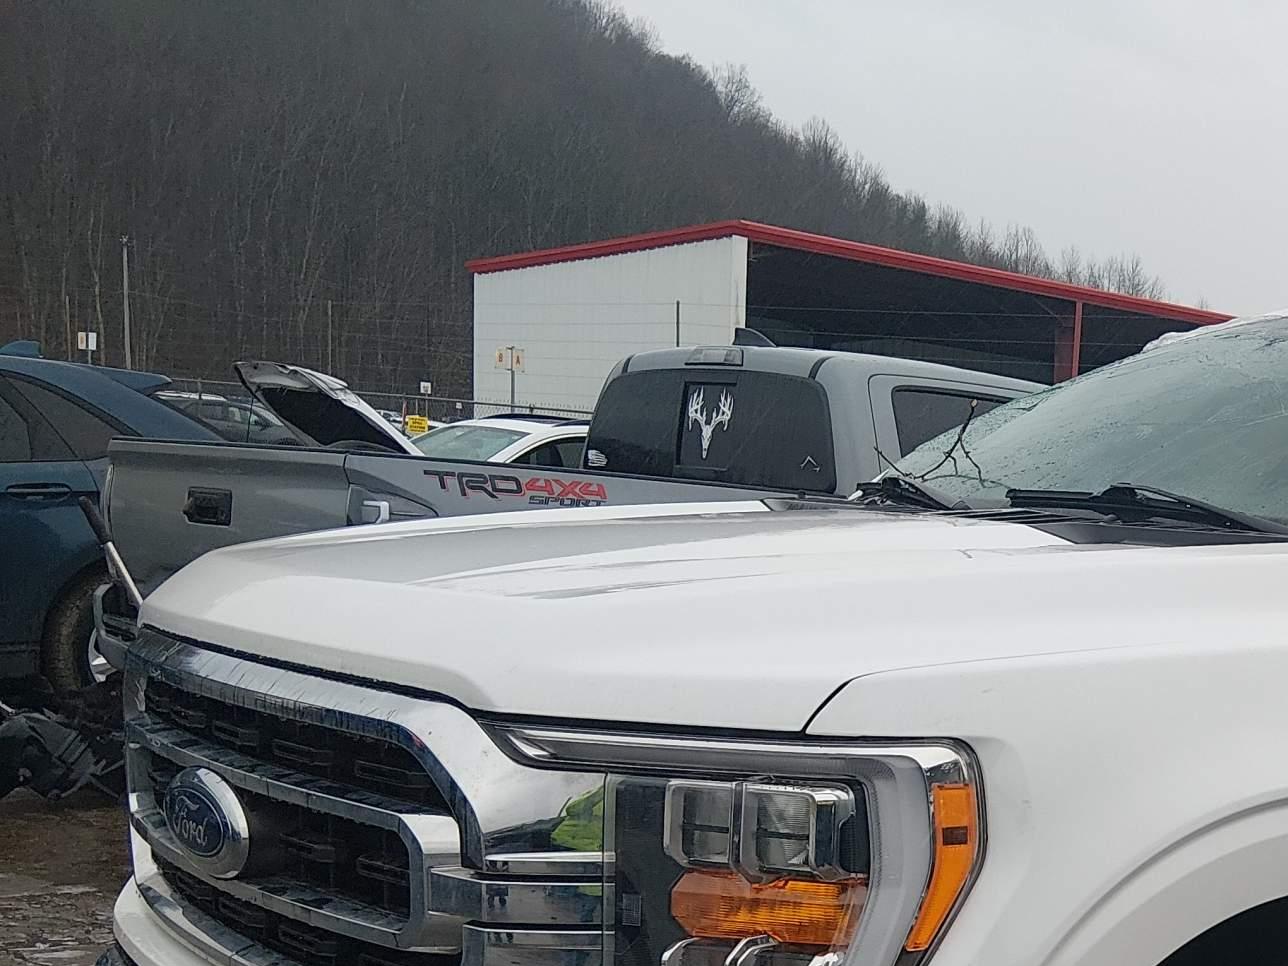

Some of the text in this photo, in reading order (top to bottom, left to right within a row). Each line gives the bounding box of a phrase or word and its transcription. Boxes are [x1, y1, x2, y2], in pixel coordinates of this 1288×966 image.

[424, 470, 524, 499] TRD
[529, 495, 607, 507] SPORT
[173, 795, 208, 846] Ford
